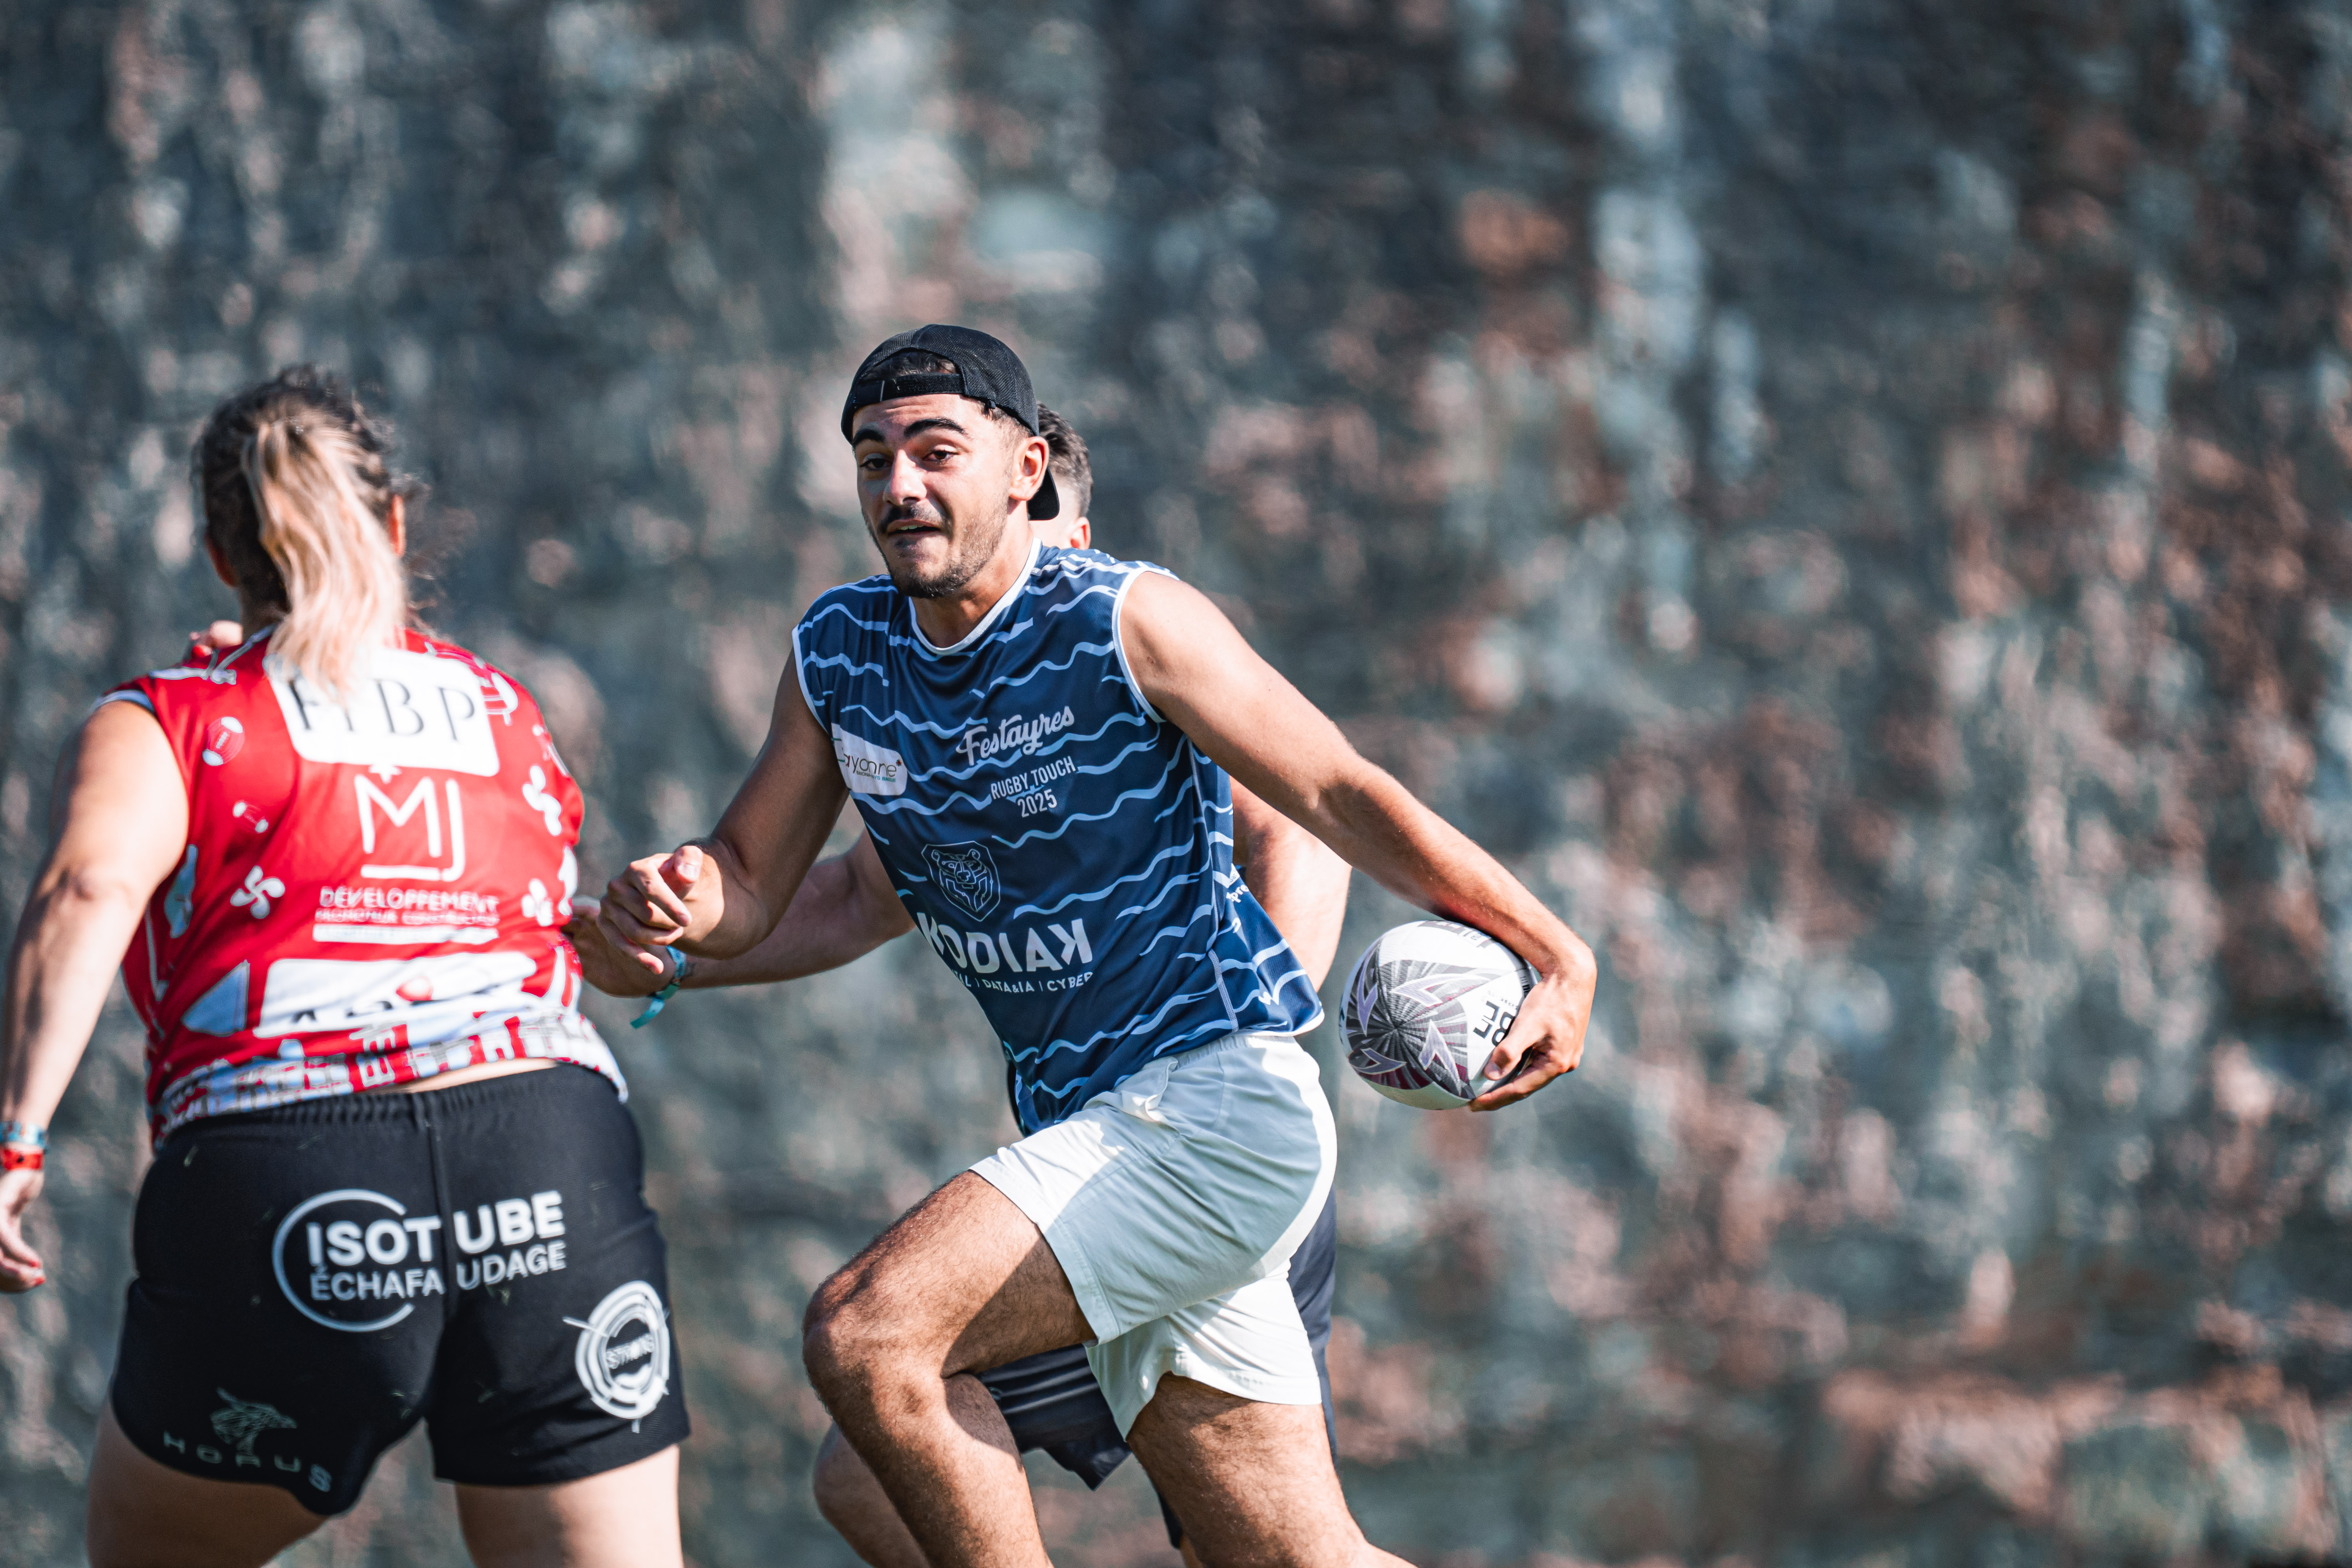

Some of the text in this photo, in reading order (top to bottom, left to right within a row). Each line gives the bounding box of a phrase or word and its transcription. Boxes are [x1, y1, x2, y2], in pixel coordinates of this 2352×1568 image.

[955, 706, 1075, 766] Festayres
[990, 755, 1076, 800] RUGBY TOUCH
[1017, 788, 1058, 818] 2025
